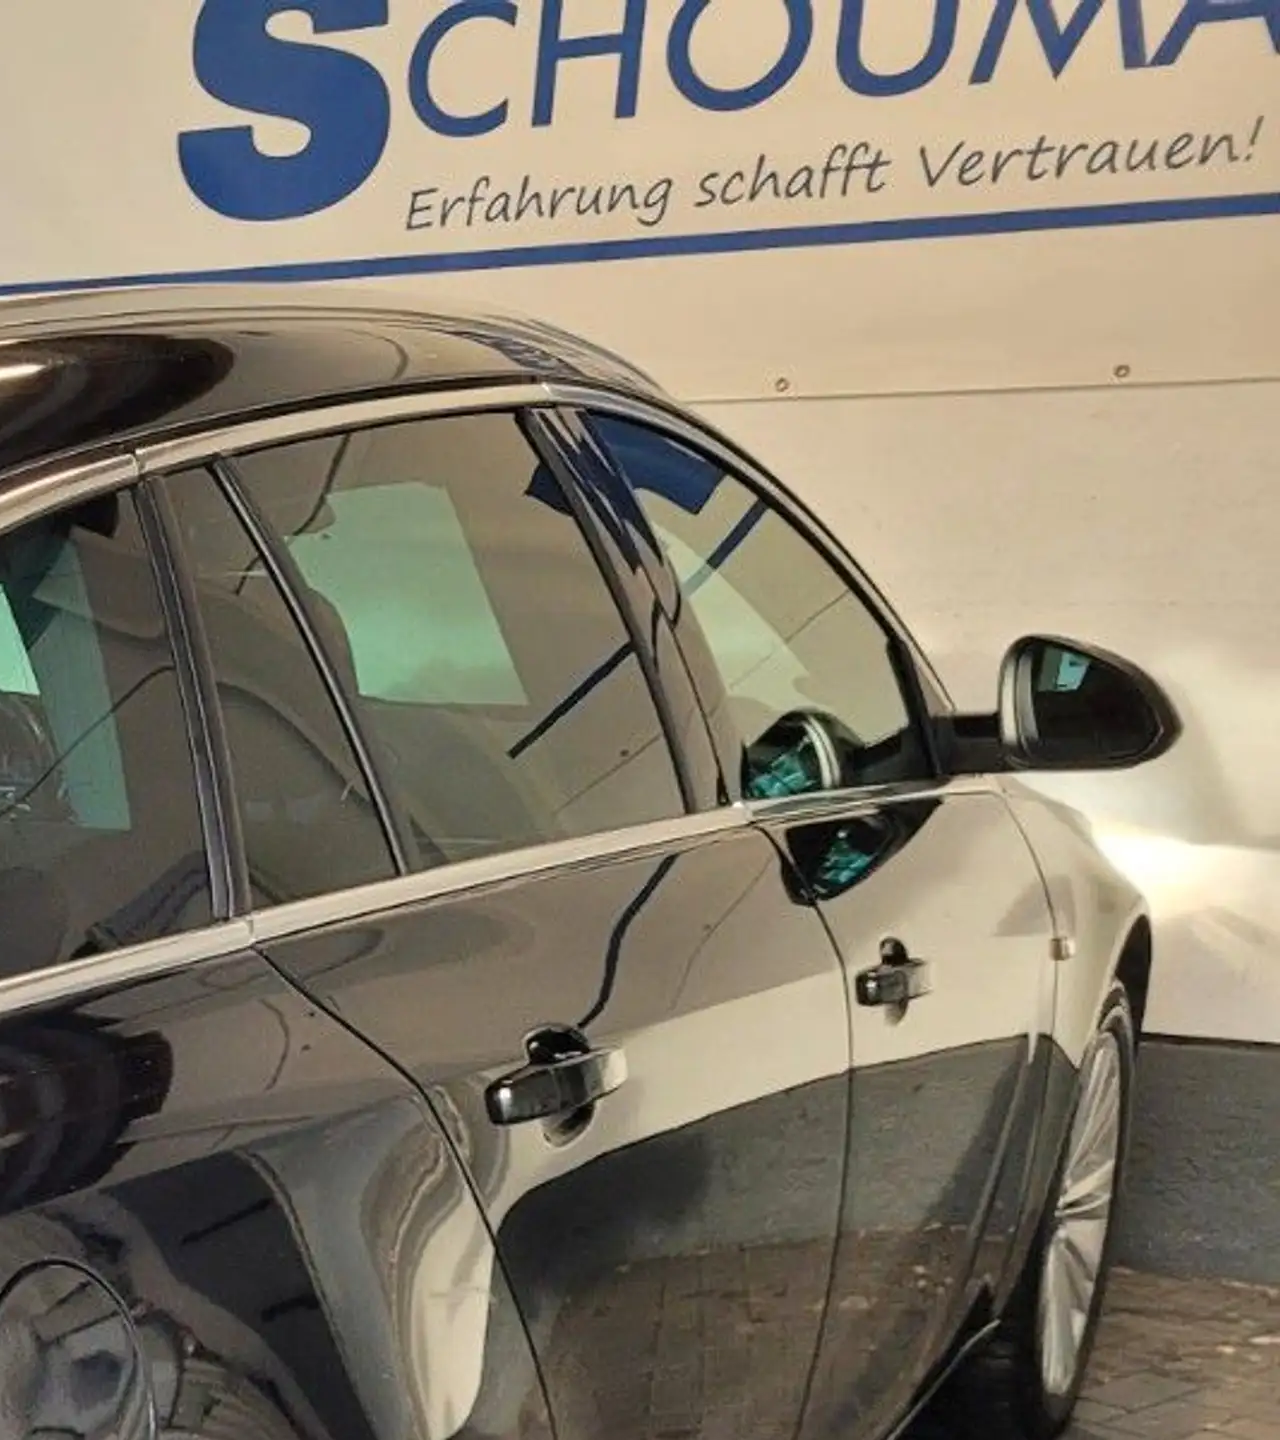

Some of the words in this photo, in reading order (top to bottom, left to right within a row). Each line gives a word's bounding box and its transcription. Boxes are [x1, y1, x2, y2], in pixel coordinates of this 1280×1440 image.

[406, 176, 672, 230] Erfahrung
[692, 142, 890, 208] schafft
[919, 116, 1263, 187] Vertrauen!
